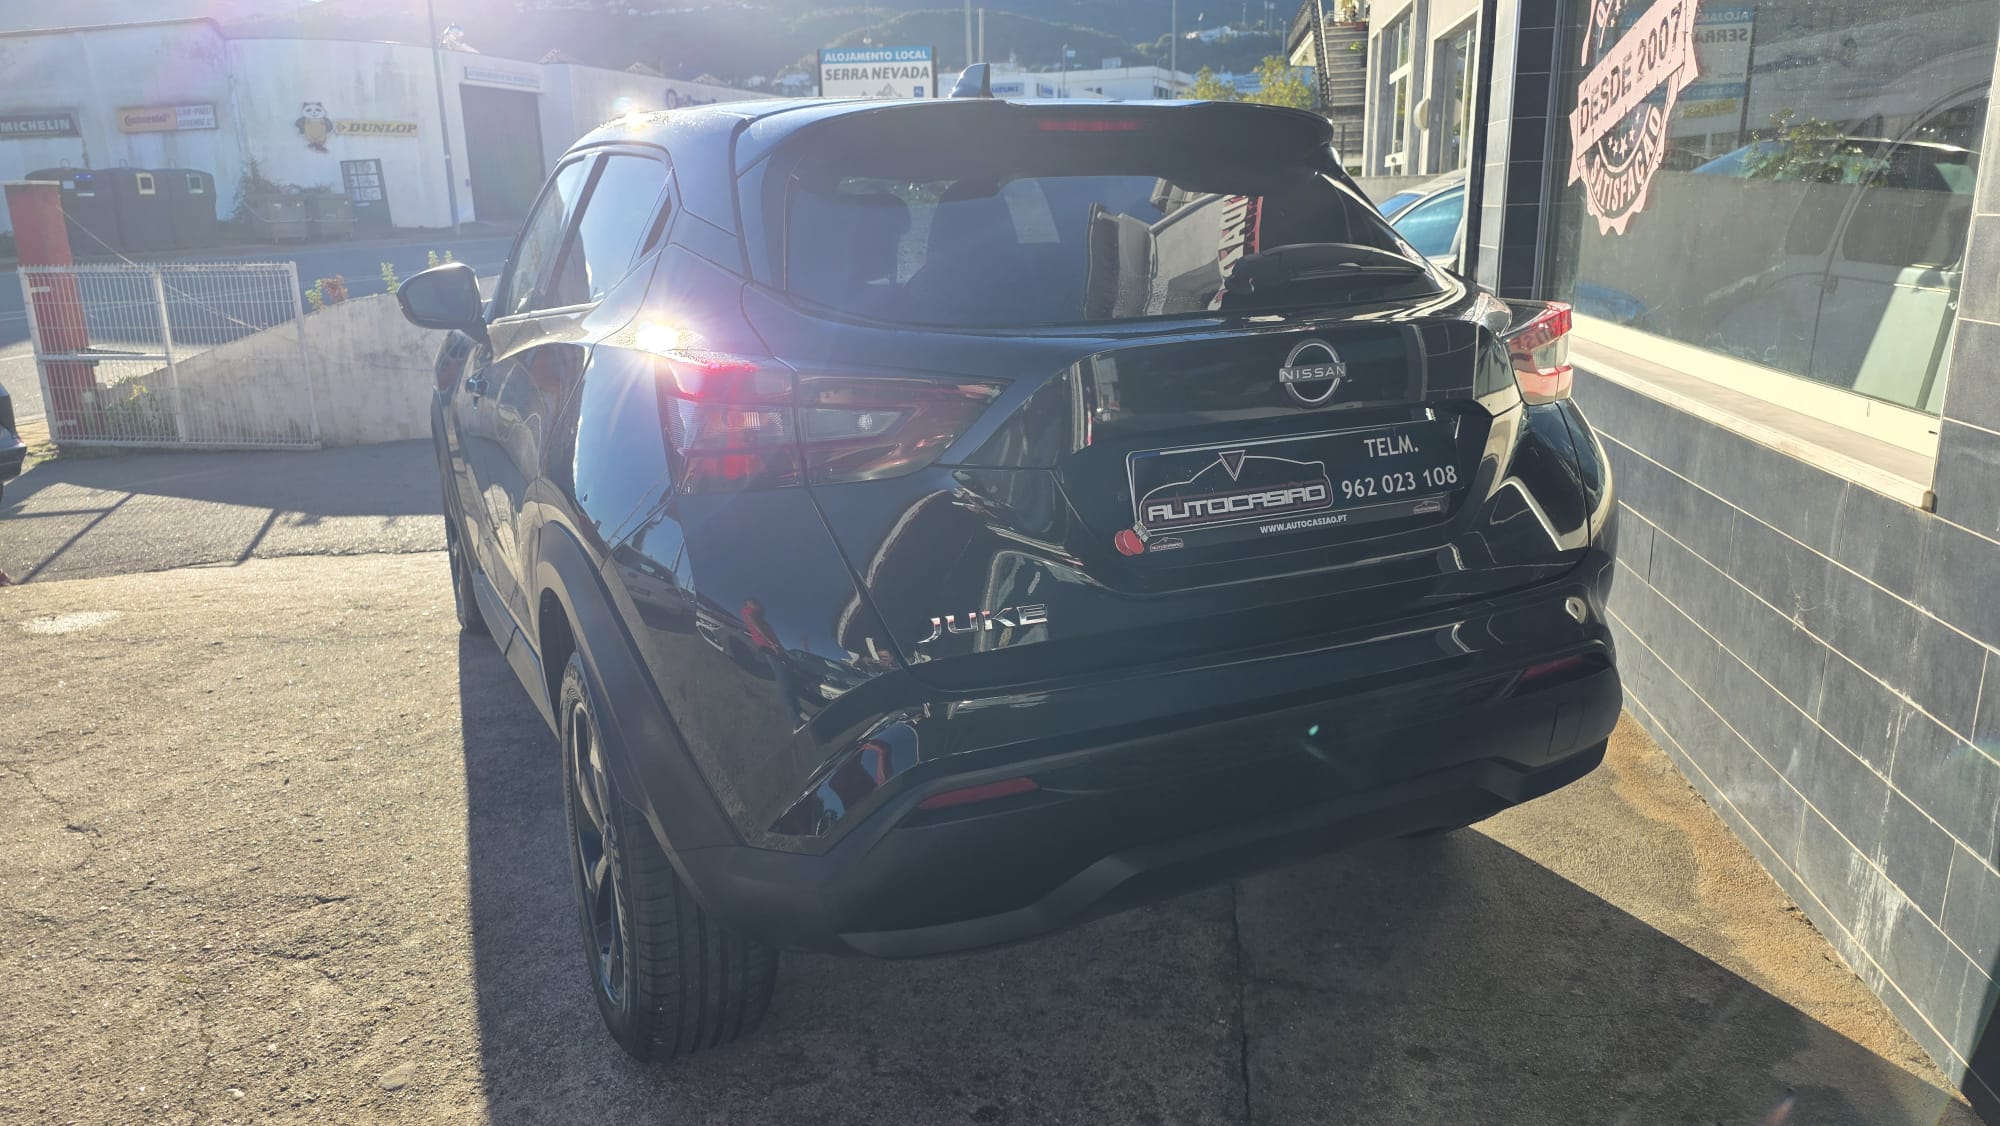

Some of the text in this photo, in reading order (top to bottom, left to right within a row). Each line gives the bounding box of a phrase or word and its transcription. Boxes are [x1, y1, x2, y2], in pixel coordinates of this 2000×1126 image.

[824, 50, 927, 62] ALOJAMENTO LOCAL
[825, 66, 929, 81] SERRA NEVADA
[1580, 2, 1682, 134] DESDE 2007
[0, 119, 70, 131] MICHELIN
[349, 123, 418, 133] DUNLOP
[1281, 365, 1345, 380] NISSAN
[1363, 434, 1419, 458] TELM.
[1341, 465, 1458, 499] 962 023 108
[1259, 514, 1348, 534] WWW.AUTOCASIAO.PT
[917, 603, 1048, 644] JUKE
